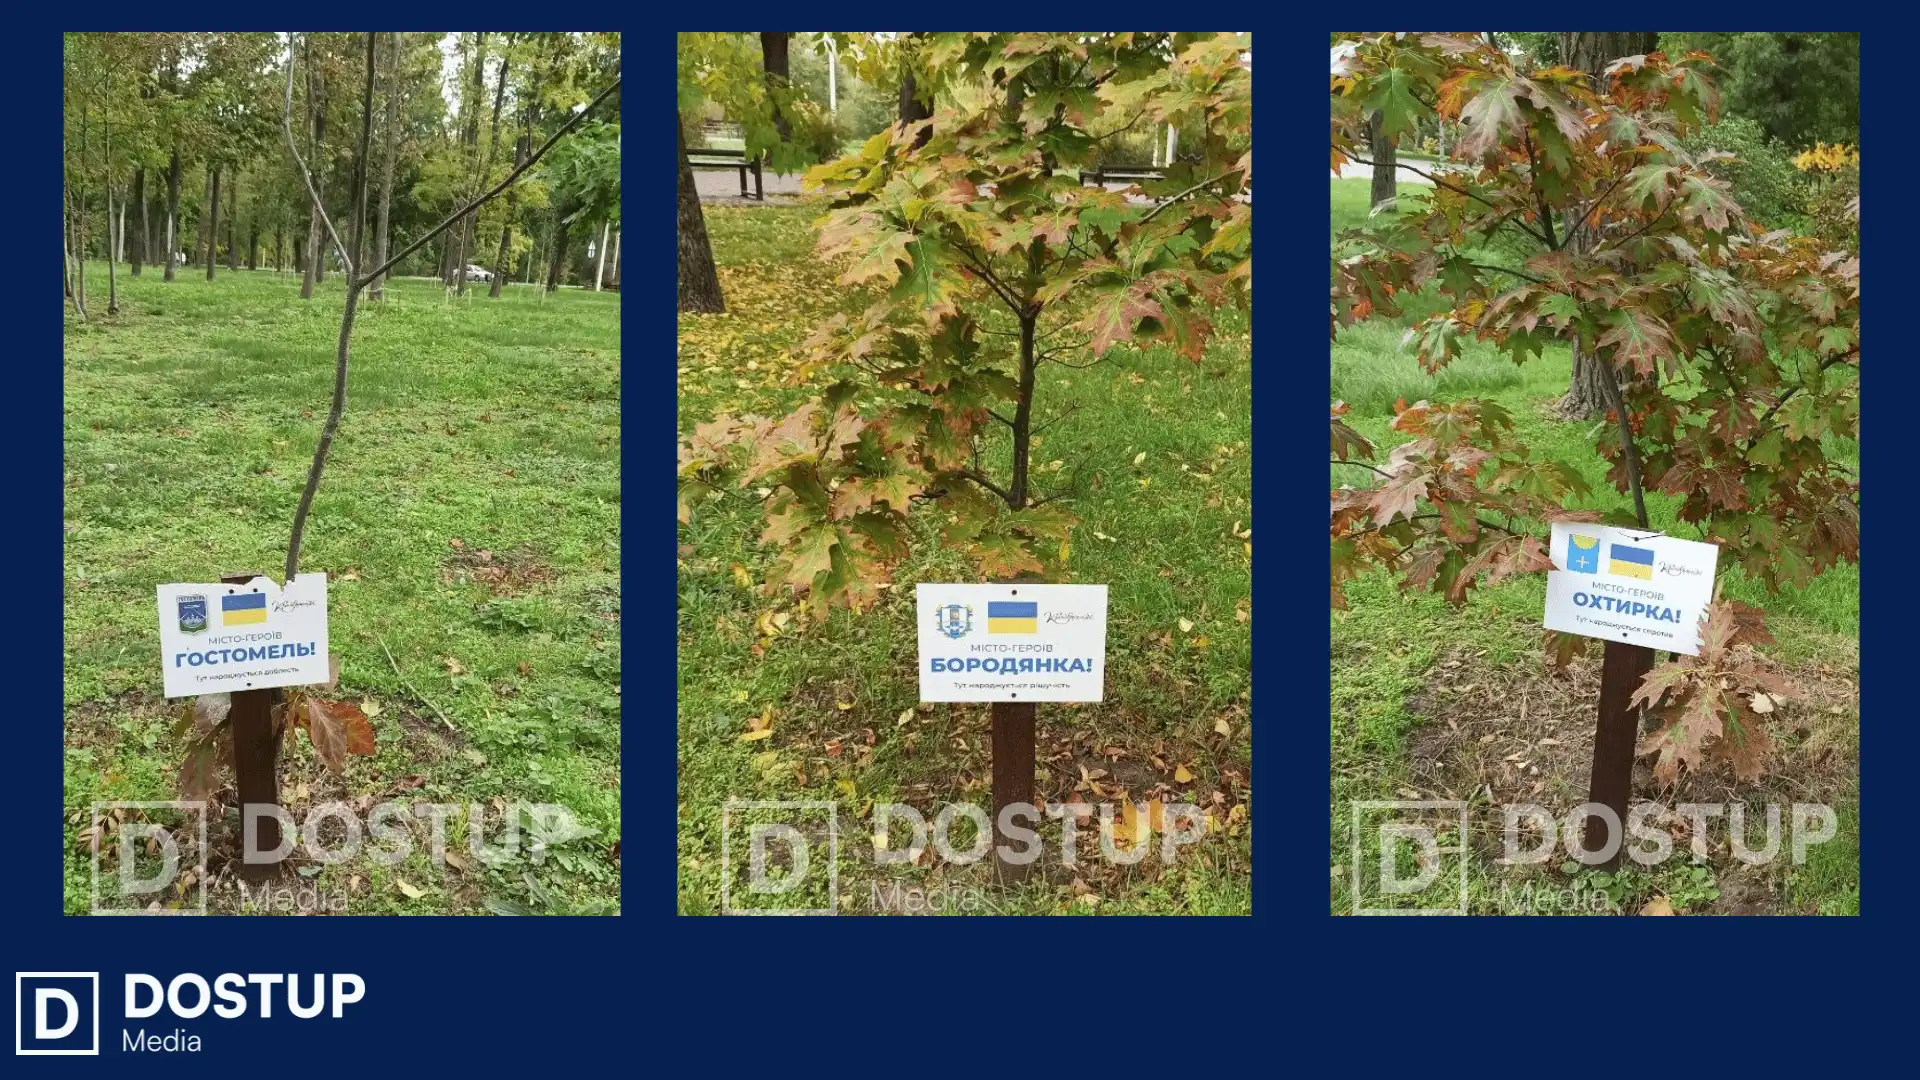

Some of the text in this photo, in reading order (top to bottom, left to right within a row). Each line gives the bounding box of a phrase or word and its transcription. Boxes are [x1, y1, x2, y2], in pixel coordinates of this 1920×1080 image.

[1592, 581, 1664, 601] МІСТО-ГЕРОЇВ
[1572, 592, 1681, 624] ОХТИРКА!
[208, 631, 283, 645] МІСТО-ГЕРОЇВ
[971, 643, 1053, 652] МІСТО-ГЕРОЇВ
[175, 641, 316, 668] ГОСТОМЕЛЬ!
[930, 657, 1093, 675] БОРОДЯНКА!
